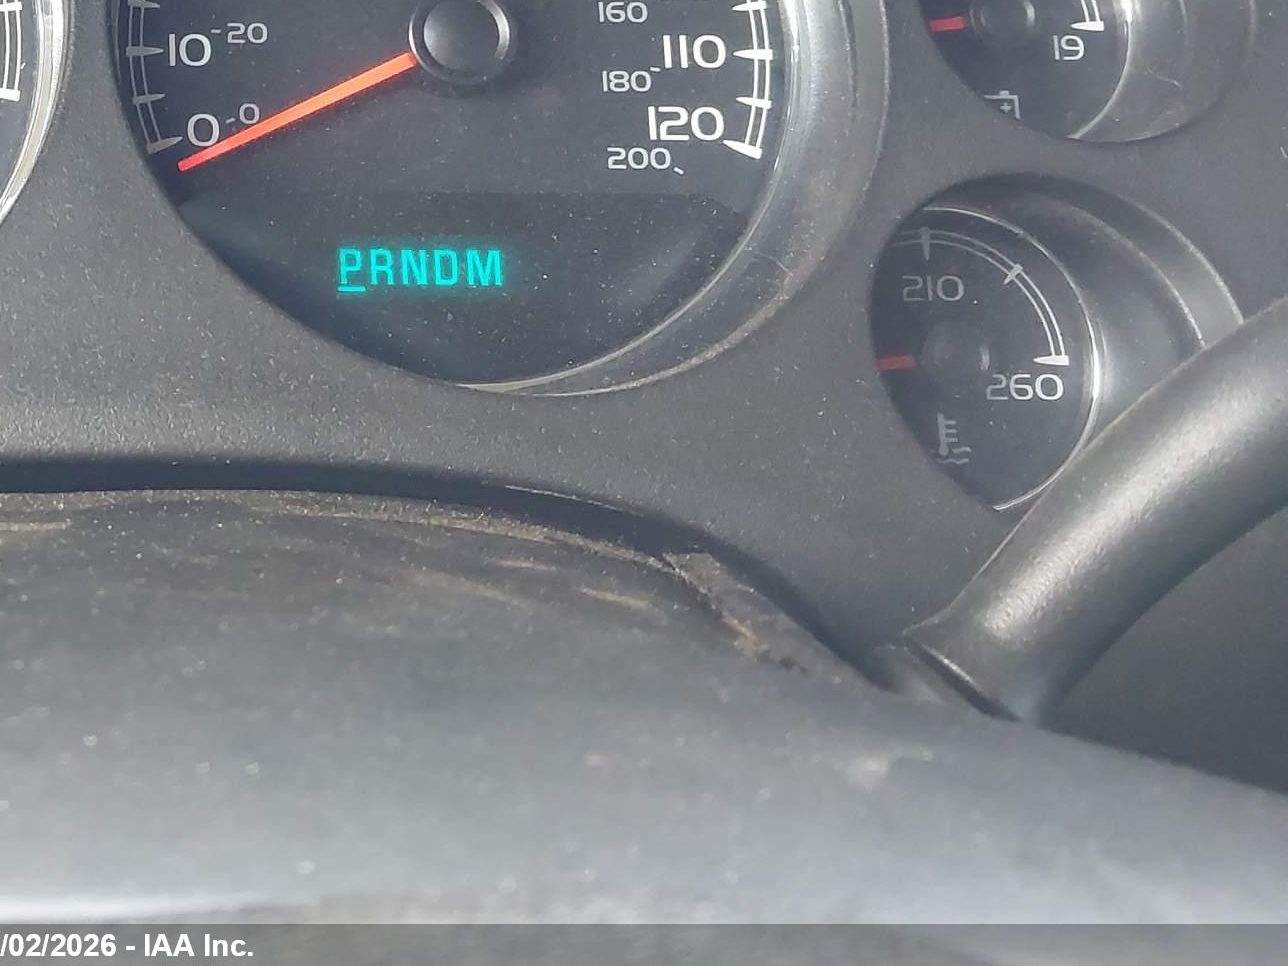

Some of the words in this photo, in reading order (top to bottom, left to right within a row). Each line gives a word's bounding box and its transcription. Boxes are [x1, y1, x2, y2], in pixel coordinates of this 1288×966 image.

[598, 1, 648, 23] 160
[227, 22, 268, 44] 20
[168, 34, 213, 68] 10
[662, 34, 727, 69] 110
[1053, 35, 1085, 61] 19
[601, 70, 651, 93] 180
[237, 103, 262, 126] 0
[647, 106, 725, 142] 120
[186, 112, 221, 146] 0
[607, 147, 672, 170] 200
[337, 248, 504, 292] PRNDM
[902, 275, 965, 302] 210
[985, 372, 1065, 402] 260
